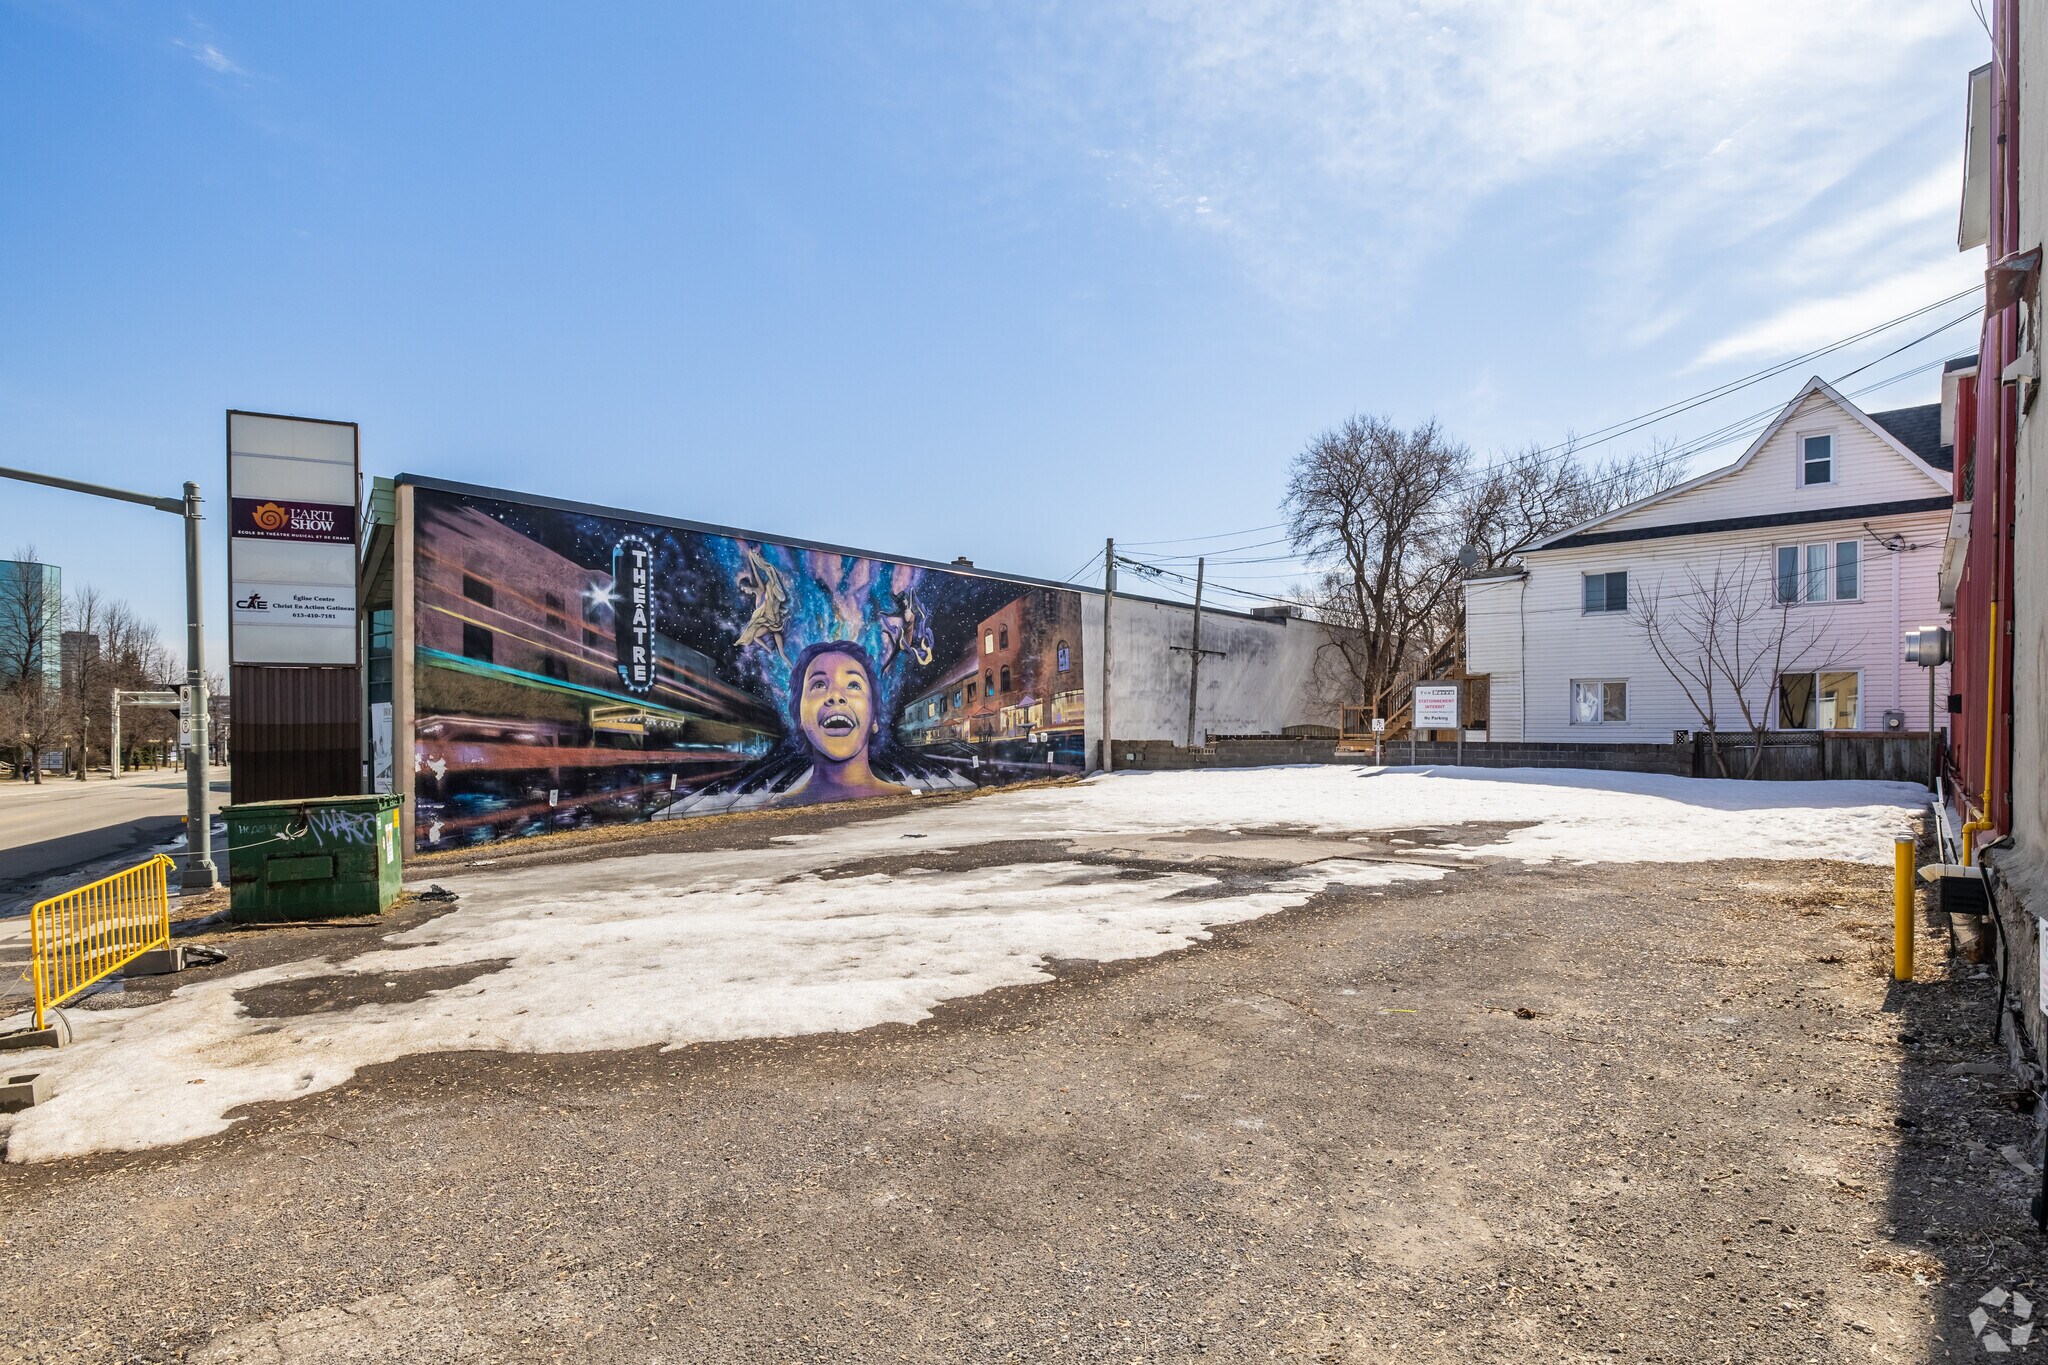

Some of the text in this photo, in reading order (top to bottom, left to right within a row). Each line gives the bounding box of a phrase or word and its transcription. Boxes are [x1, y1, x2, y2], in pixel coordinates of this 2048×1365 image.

[290, 519, 335, 532] SHOW
[293, 594, 313, 602] Église
[631, 549, 648, 682] THÉÂTRE
